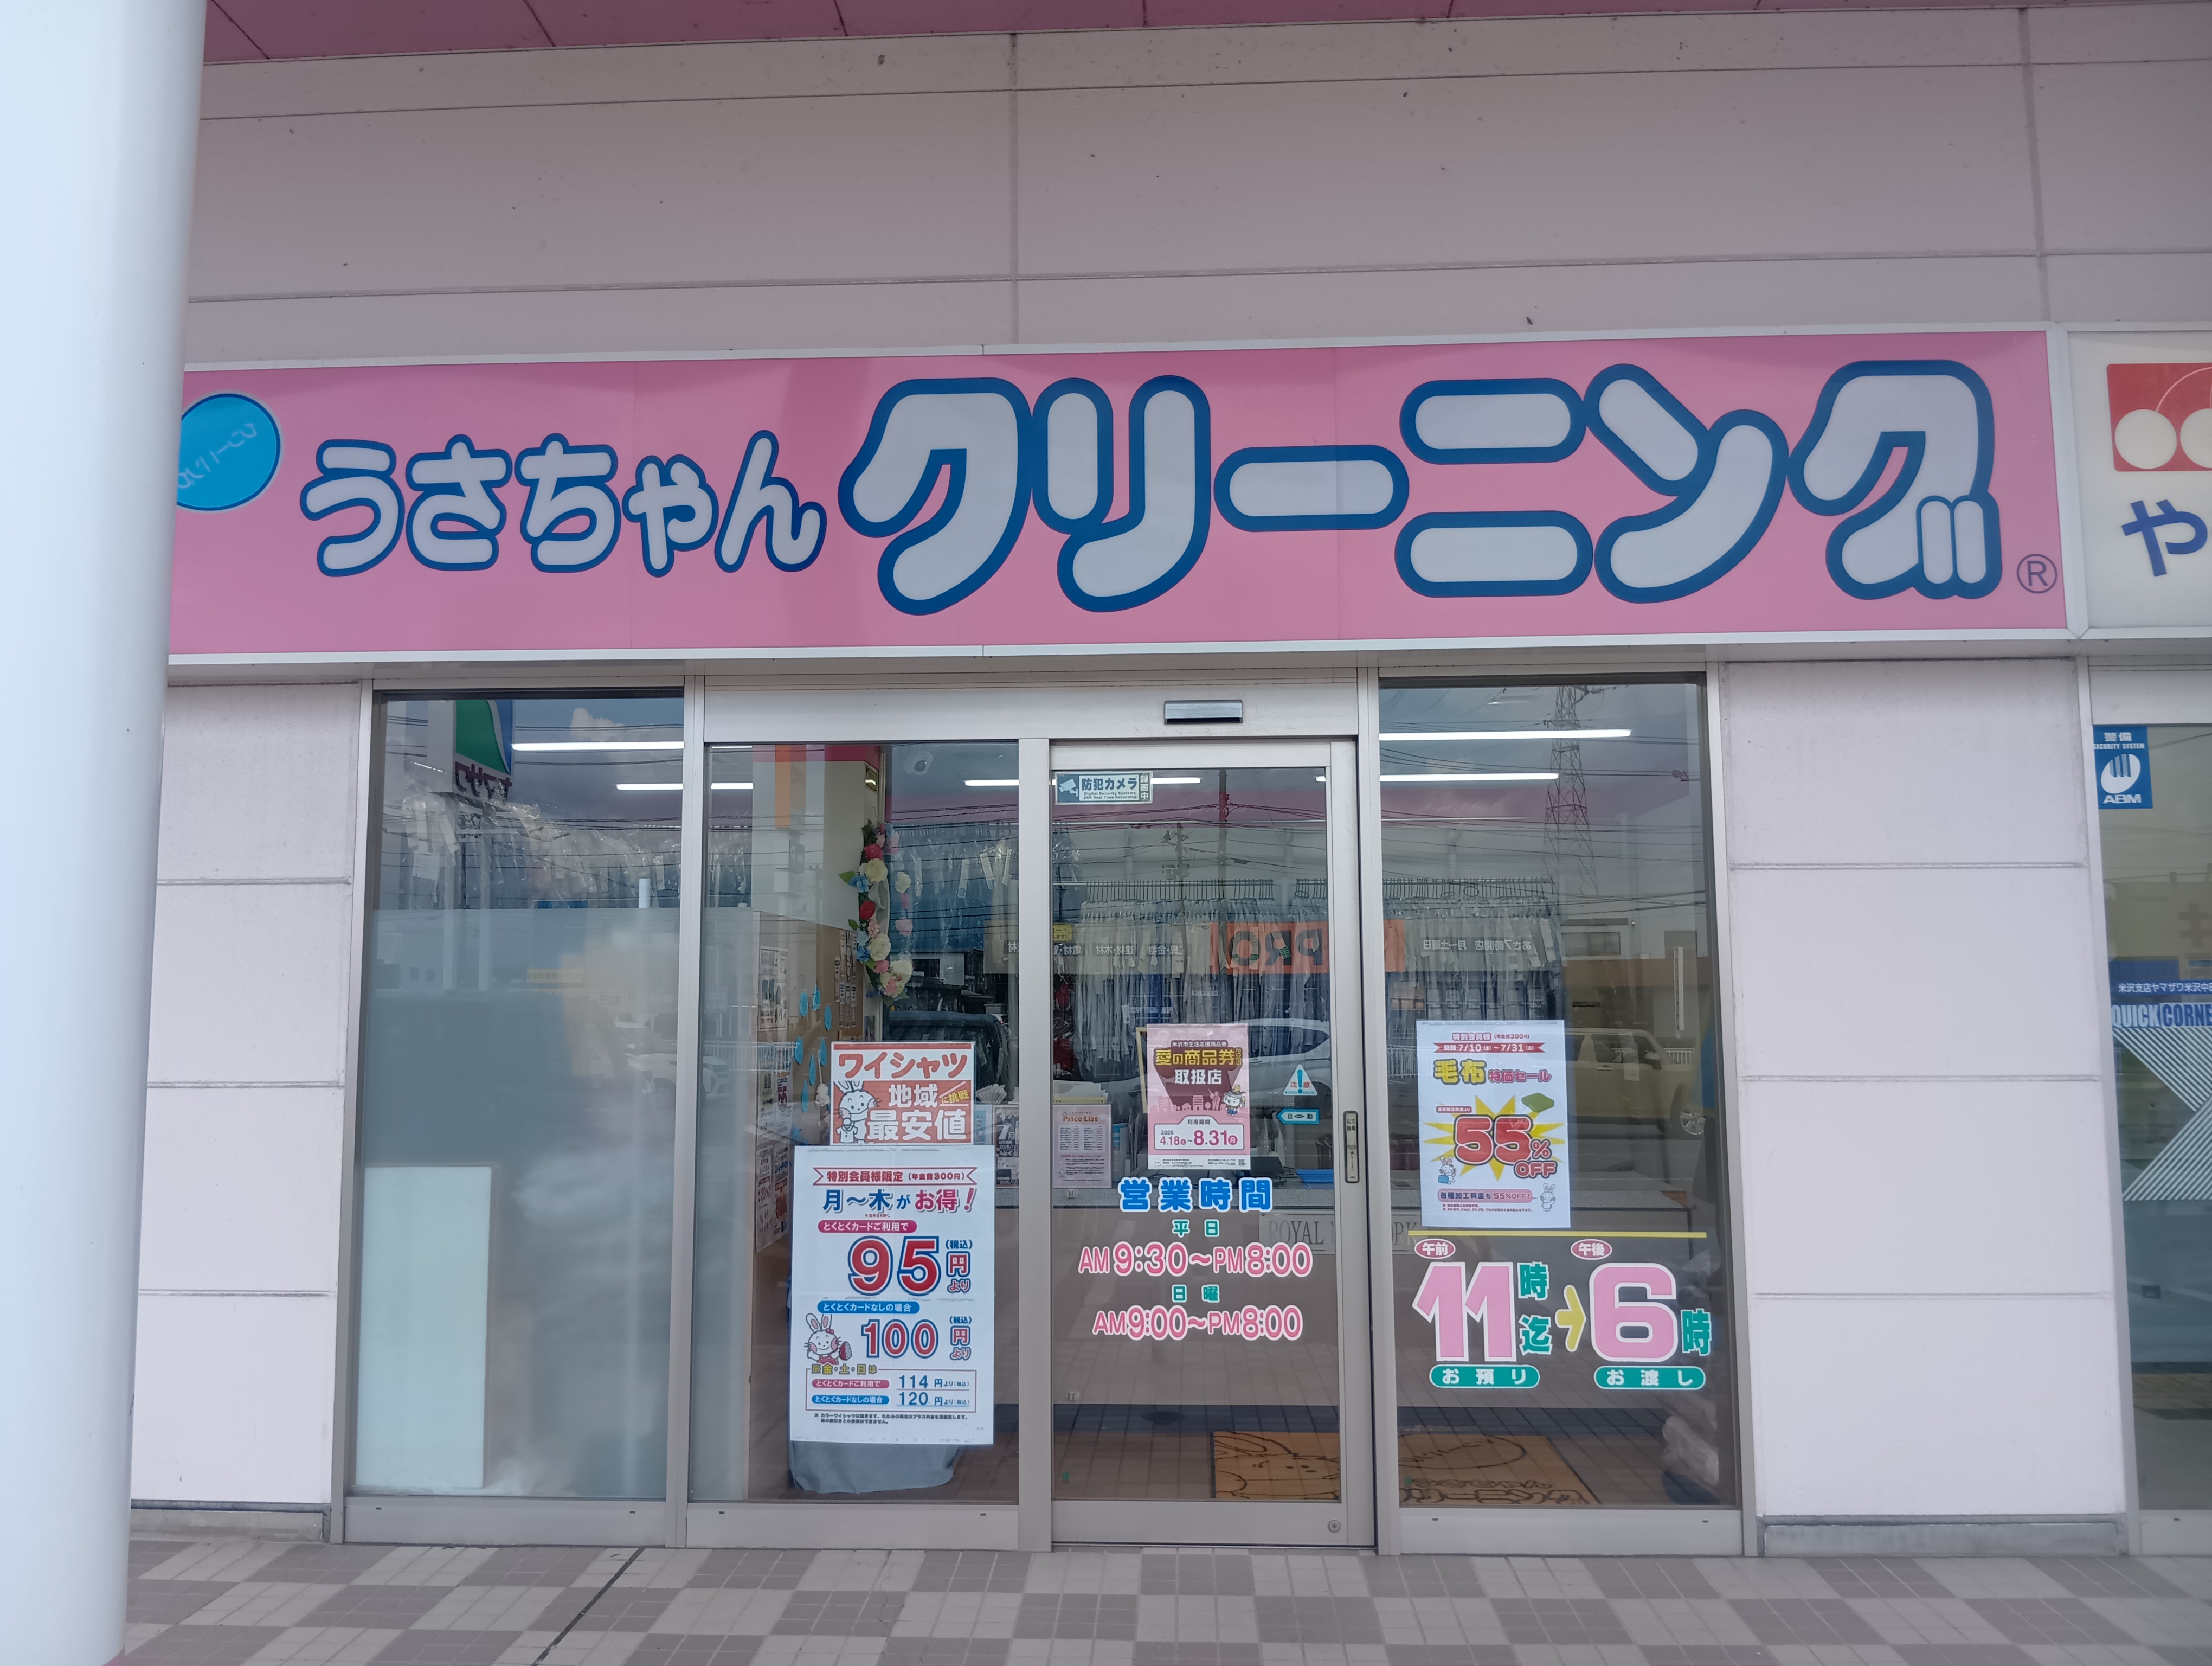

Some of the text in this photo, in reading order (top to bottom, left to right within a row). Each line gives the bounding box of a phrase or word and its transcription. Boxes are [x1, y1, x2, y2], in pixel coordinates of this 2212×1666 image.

[2104, 732, 2132, 742] 警備
[1082, 778, 1137, 791] 防犯カメラ
[2111, 1004, 2160, 1028] QUICK
[1452, 1033, 1491, 1041] 特別会員様
[838, 1052, 967, 1078] ワイシャツ
[1155, 1049, 1234, 1065] 愛の商品券
[1175, 1069, 1222, 1085] 取扱店
[1433, 1058, 1552, 1085] 毛布 特価セール
[888, 1084, 938, 1108] 地域
[867, 1109, 966, 1141] 最安値
[827, 1171, 903, 1182] 特別会員様限定
[1514, 1160, 1558, 1178] OFF
[1118, 1176, 1272, 1212] 営業時間
[823, 1221, 909, 1231] とくとくカードご利用で
[1268, 1220, 1324, 1245] ROYAL
[1421, 1241, 1449, 1257] 午前
[1578, 1241, 1605, 1257] 午後
[847, 1235, 942, 1296] 95
[823, 1303, 911, 1313] とくとくカードなしの場合
[1412, 1261, 1517, 1362] 11
[1589, 1263, 1712, 1362] 6 時
[861, 1319, 939, 1359] 100
[899, 1375, 929, 1389] 114
[1442, 1368, 1526, 1385] お預り
[1606, 1368, 1694, 1386] お渡し
[899, 1392, 929, 1405] 120
